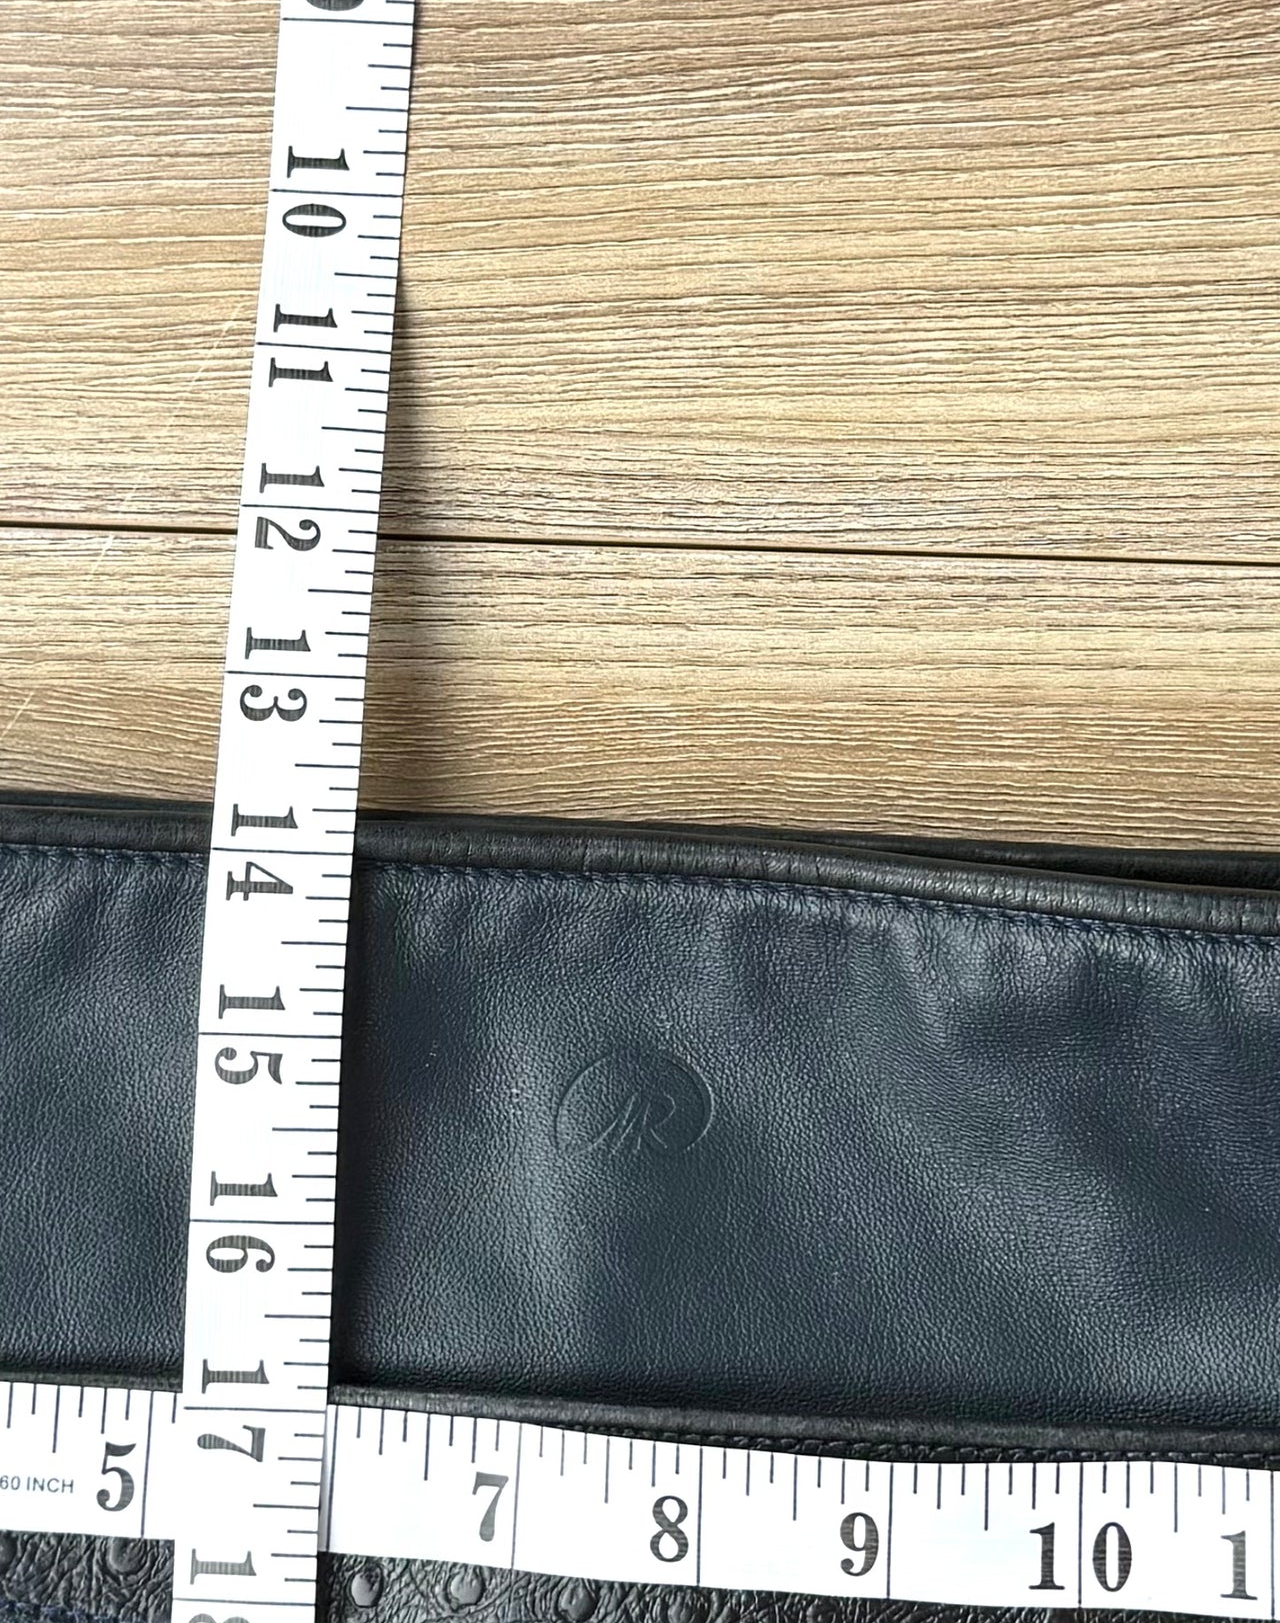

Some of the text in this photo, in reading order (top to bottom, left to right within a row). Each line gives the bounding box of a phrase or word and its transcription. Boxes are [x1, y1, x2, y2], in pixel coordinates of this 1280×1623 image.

[282, 146, 350, 238] 10
[268, 303, 338, 388] 11
[254, 462, 325, 552] 12
[239, 627, 311, 722] 13
[226, 803, 298, 901] 14
[214, 984, 286, 1085] 15
[205, 1171, 278, 1273] 16
[197, 1359, 270, 1462] 17
[0, 1474, 75, 1494] 60 INCH
[95, 1442, 137, 1512] 5
[472, 1471, 510, 1542] 7
[649, 1495, 690, 1563] 8
[839, 1512, 880, 1577] 9
[1029, 1521, 1133, 1593] 10
